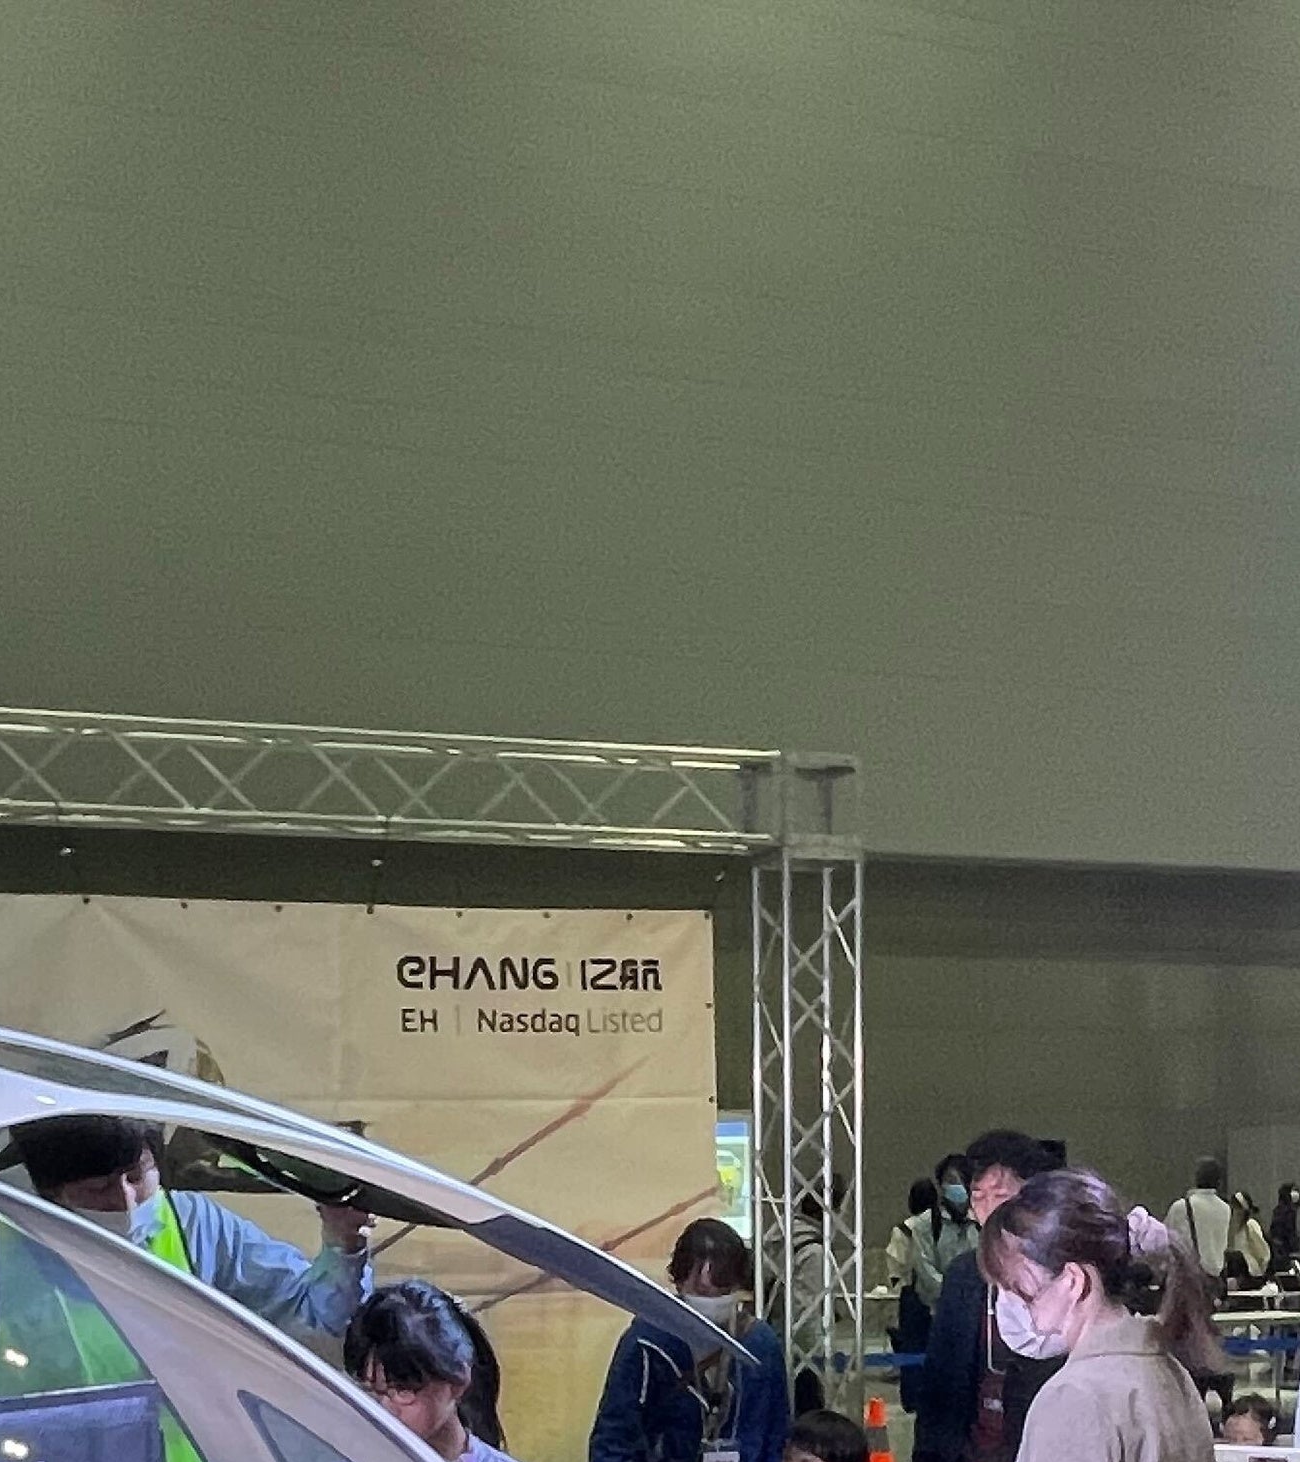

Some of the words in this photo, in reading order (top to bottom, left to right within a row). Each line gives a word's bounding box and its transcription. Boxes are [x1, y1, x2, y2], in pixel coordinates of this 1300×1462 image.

[400, 1007, 439, 1033] EH
[476, 1007, 581, 1037] Nasdaq
[586, 1006, 664, 1034] Listed
